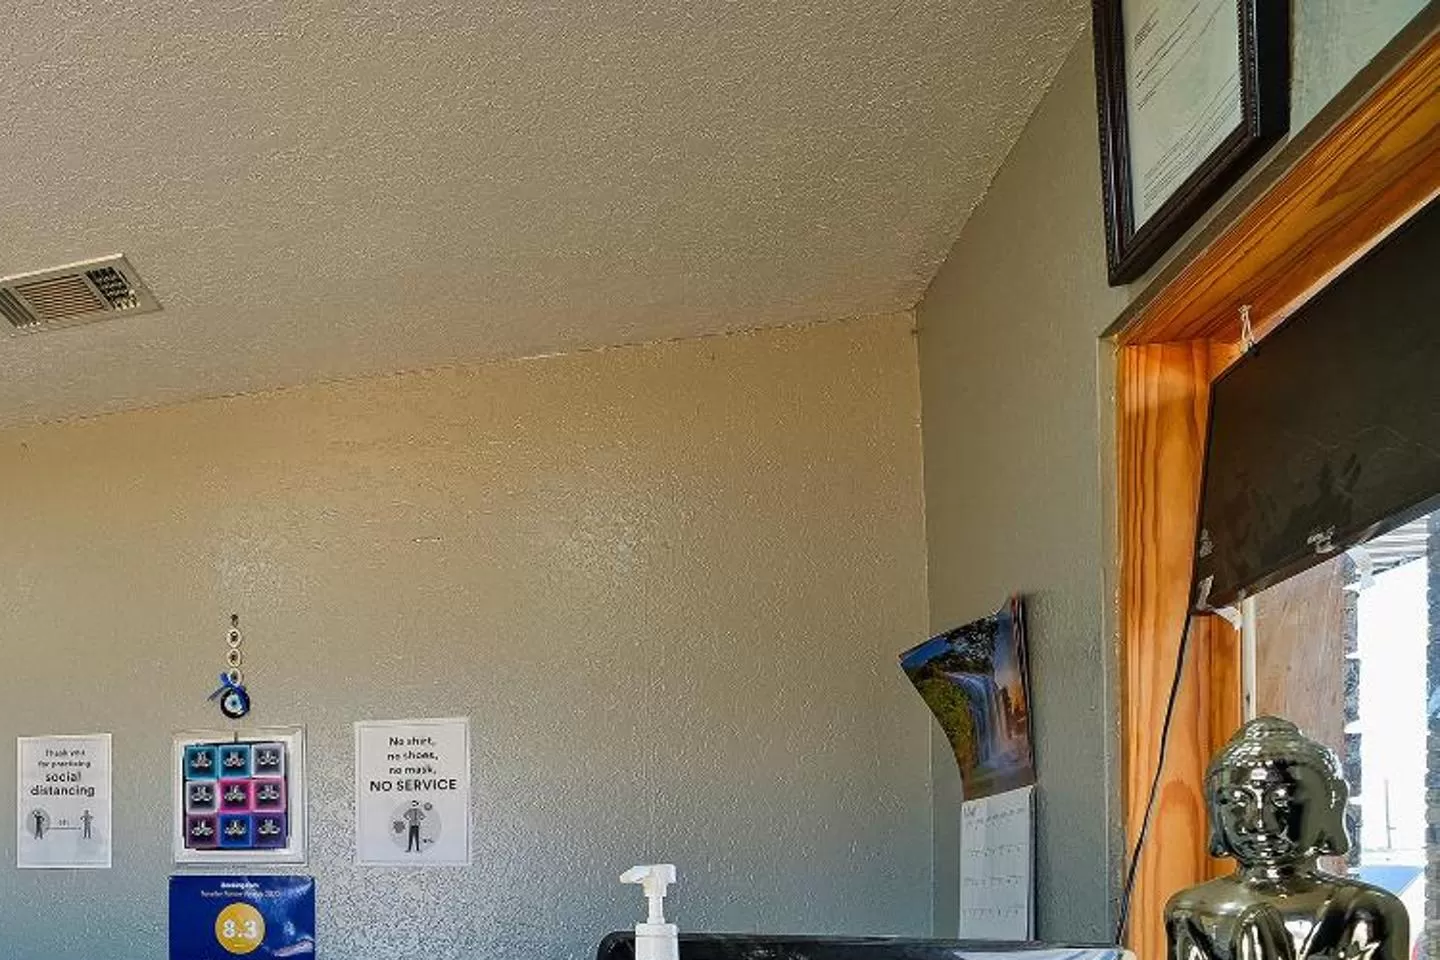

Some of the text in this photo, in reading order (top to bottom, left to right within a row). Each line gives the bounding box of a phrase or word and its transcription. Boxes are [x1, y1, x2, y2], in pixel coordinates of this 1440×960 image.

[389, 736, 404, 746] No
[387, 752, 401, 761] no
[389, 766, 402, 775] no
[45, 771, 82, 782] social
[369, 779, 457, 791] NO SERVICE
[30, 784, 96, 798] distancing
[222, 918, 258, 939] 8.3
